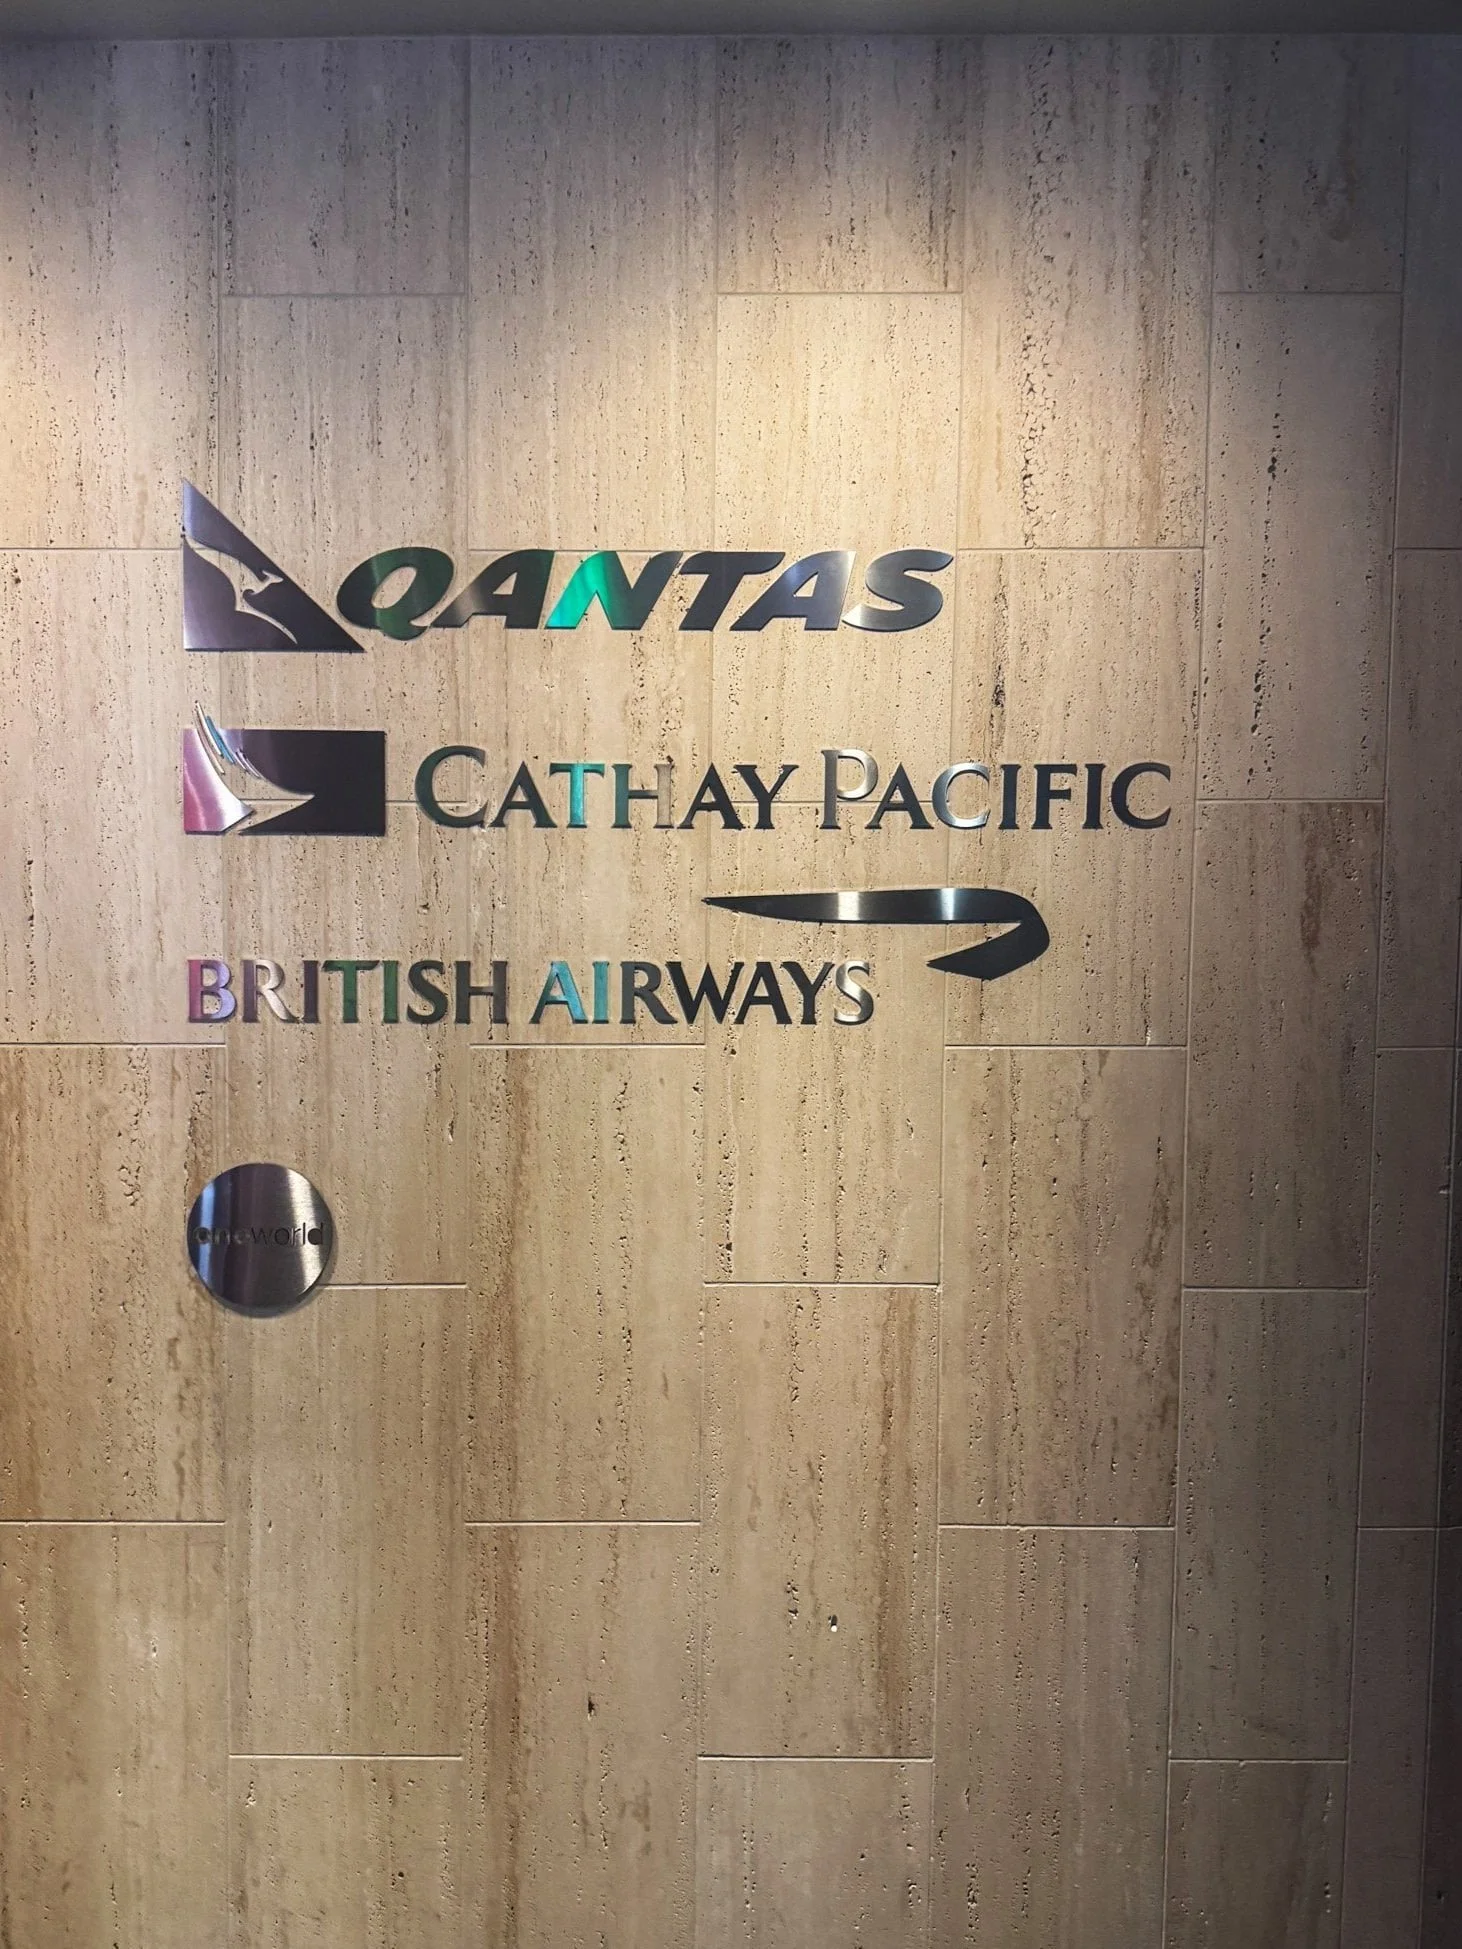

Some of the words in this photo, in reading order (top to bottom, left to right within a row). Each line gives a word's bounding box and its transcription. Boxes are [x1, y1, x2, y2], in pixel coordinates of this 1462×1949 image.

[336, 546, 955, 640] QANTAS
[413, 744, 799, 830] CATHAY
[820, 746, 1173, 831] PACIFIC
[187, 957, 509, 1026] BRITISH
[530, 957, 876, 1027] AIRWAYS
[192, 1221, 324, 1246] oneworld
